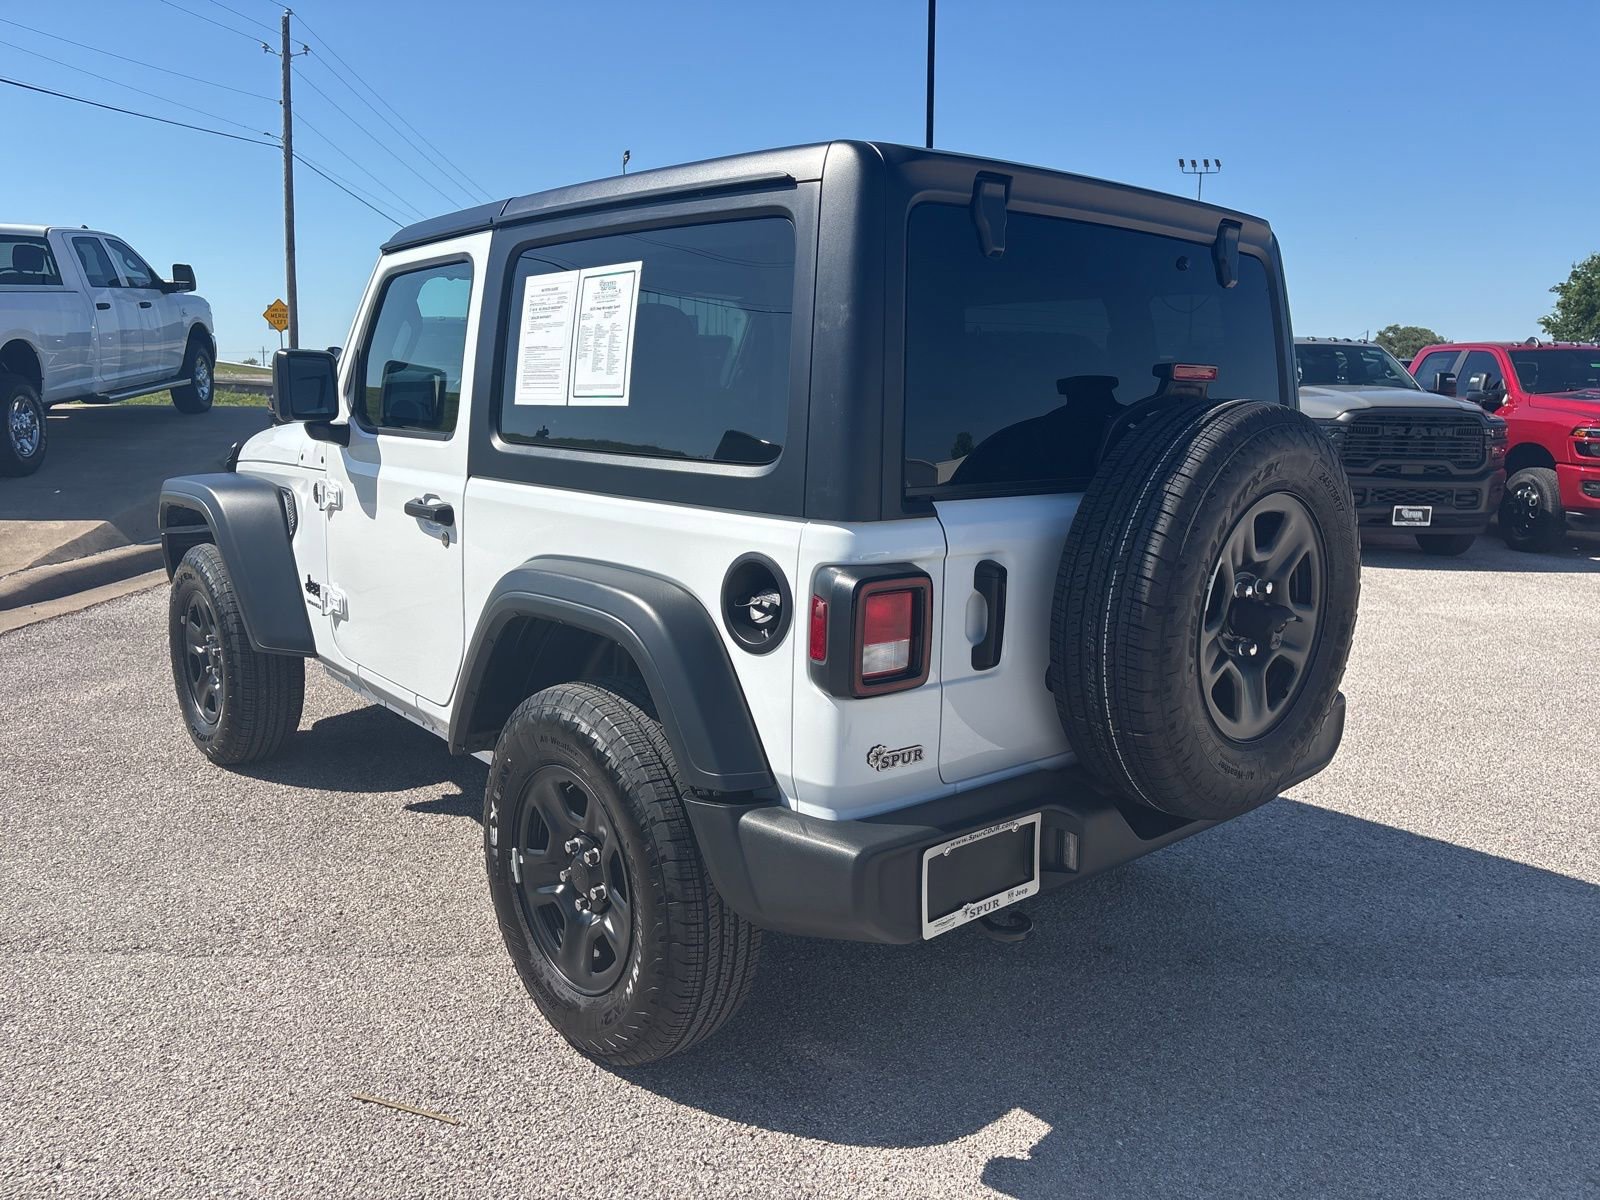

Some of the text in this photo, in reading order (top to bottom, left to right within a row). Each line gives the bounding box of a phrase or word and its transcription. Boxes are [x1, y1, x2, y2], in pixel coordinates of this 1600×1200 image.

[1384, 425, 1454, 438] RAM
[1318, 472, 1346, 513] 245/75R17
[540, 735, 578, 757] All-Weather
[880, 747, 924, 770] SPUR
[950, 821, 1015, 847] www.SpurCDJR.com
[1015, 887, 1028, 897] Jeep
[969, 899, 1000, 918] SPUR
